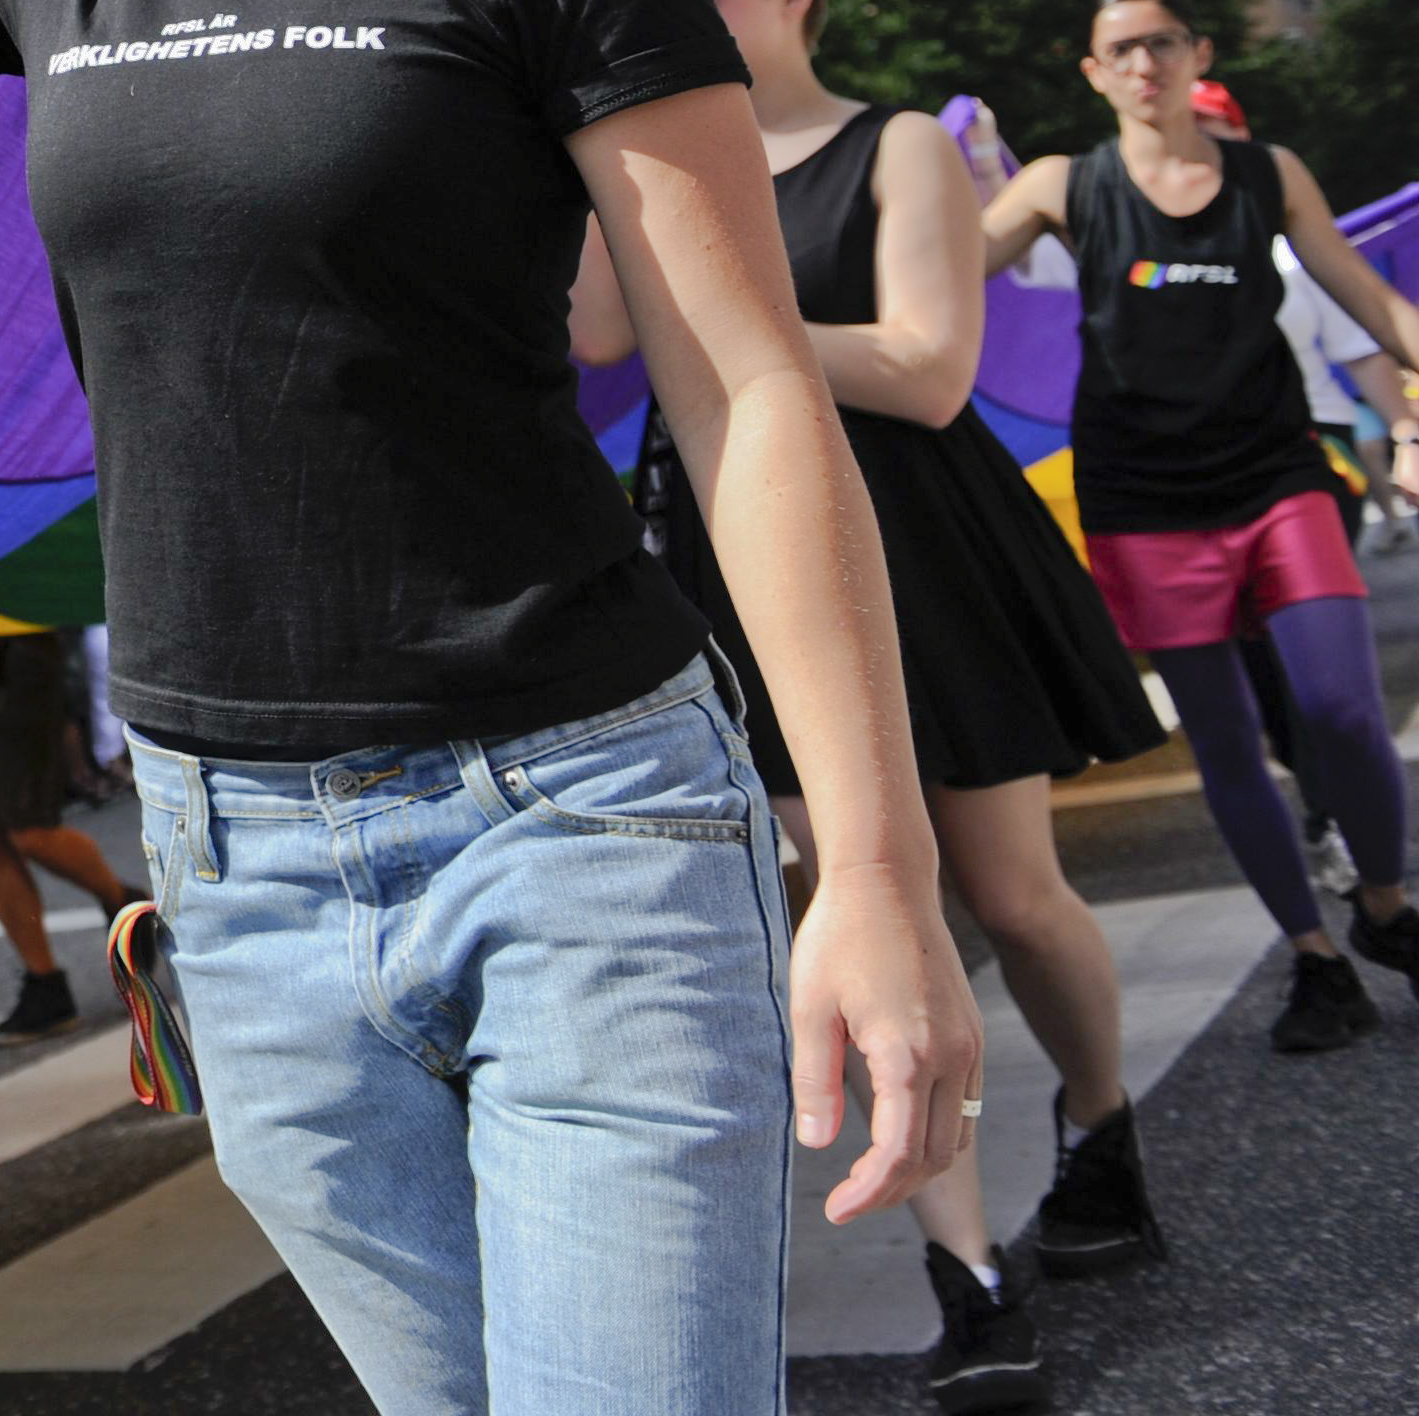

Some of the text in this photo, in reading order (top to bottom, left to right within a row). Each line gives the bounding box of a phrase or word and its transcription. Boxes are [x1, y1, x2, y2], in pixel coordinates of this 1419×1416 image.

[161, 18, 206, 36] RFSL
[48, 25, 385, 76] VERKLIGHETENS FOLK
